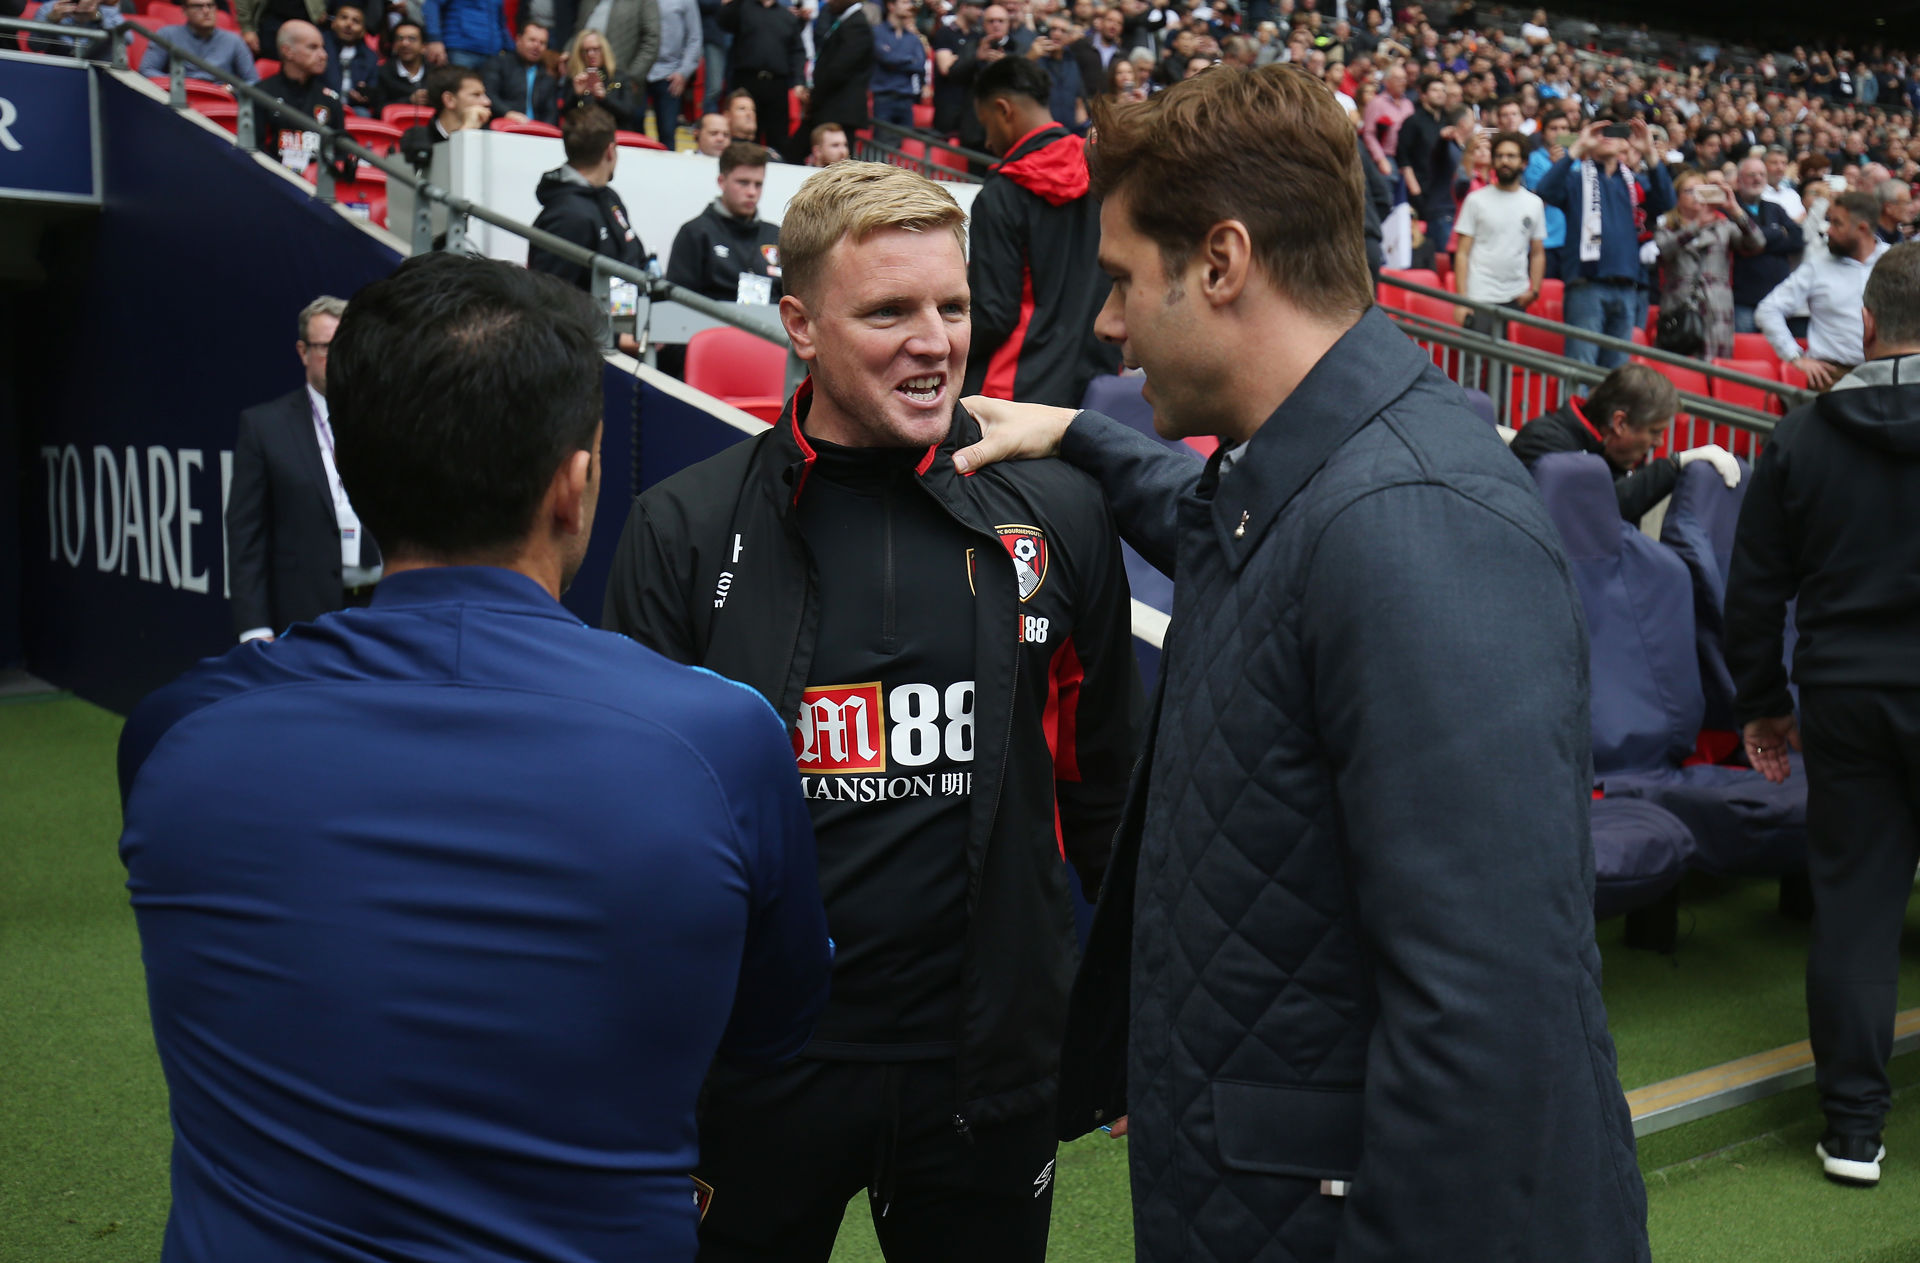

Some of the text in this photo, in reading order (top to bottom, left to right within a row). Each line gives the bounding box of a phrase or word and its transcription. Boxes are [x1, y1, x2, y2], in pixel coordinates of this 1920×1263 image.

[41, 443, 87, 568] TO
[93, 444, 210, 594] DARE
[942, 772, 973, 797] 明
